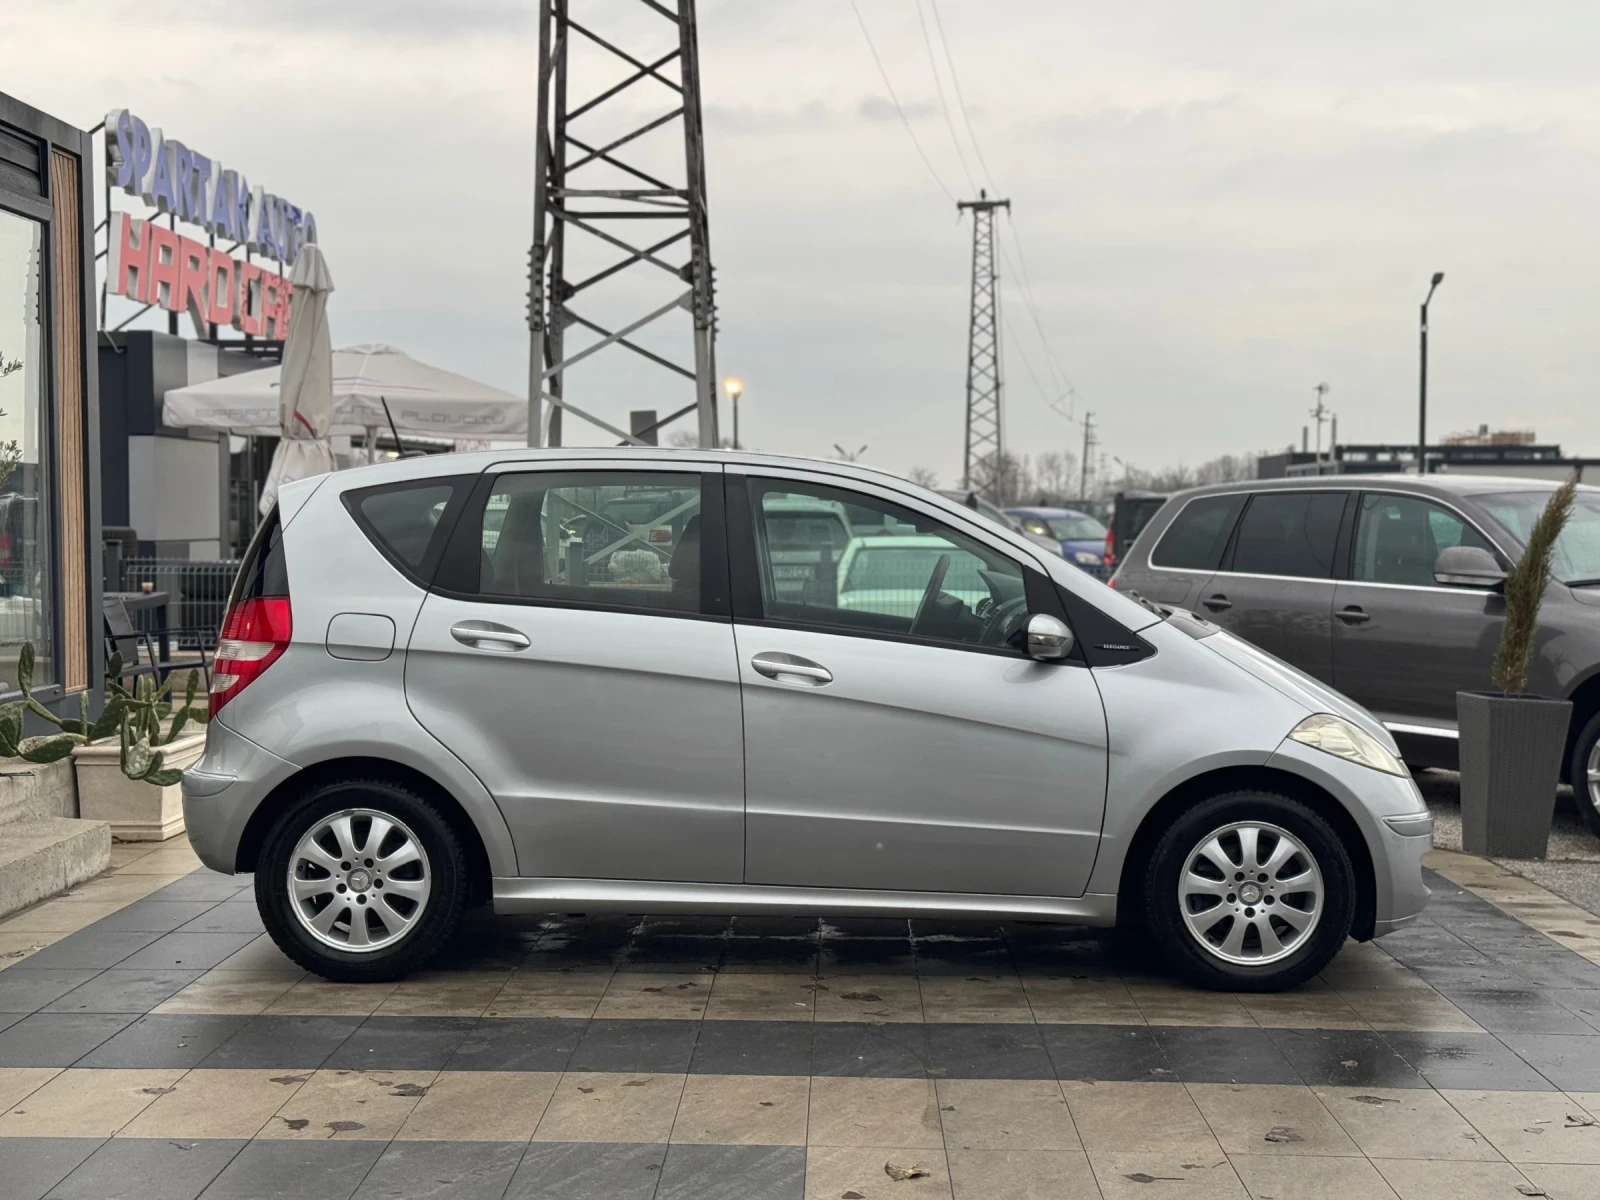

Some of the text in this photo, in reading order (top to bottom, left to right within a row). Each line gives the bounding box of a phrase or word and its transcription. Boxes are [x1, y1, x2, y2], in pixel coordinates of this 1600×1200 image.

[107, 109, 318, 265] SPARTAK AUTO
[108, 211, 234, 340] HARD
[194, 408, 278, 419] SPART
